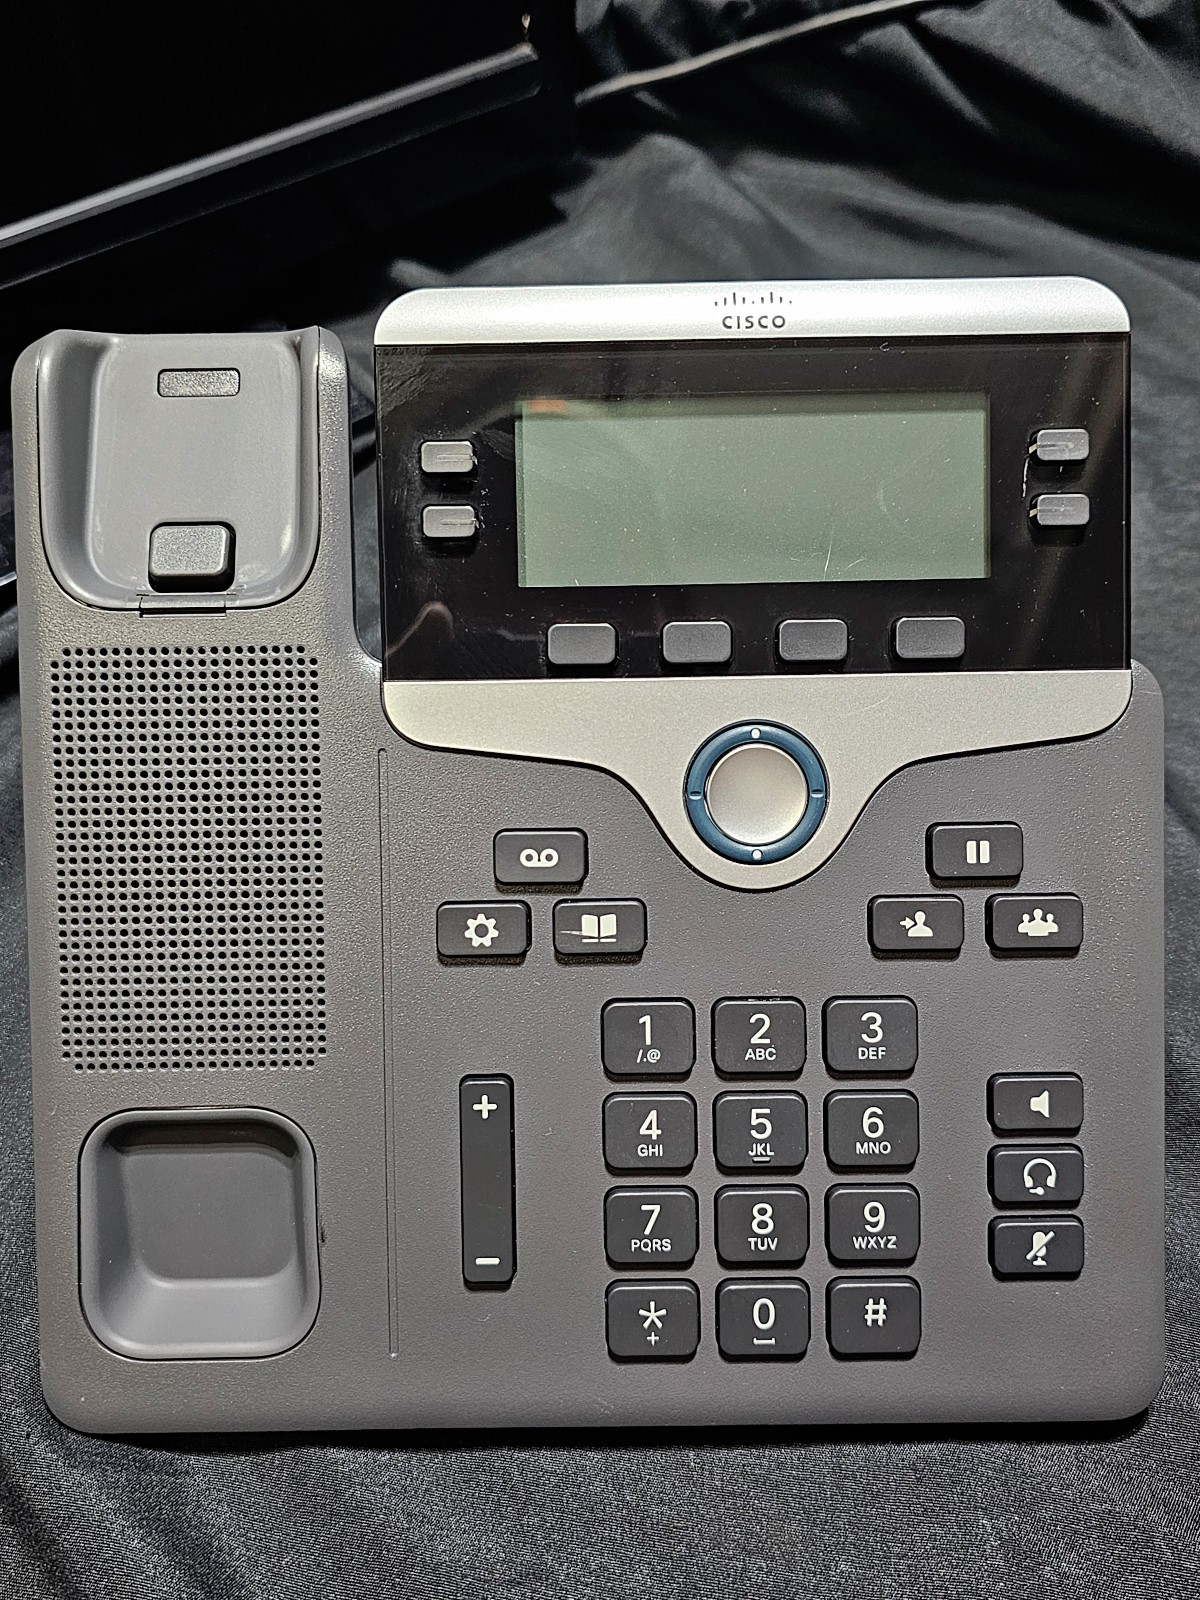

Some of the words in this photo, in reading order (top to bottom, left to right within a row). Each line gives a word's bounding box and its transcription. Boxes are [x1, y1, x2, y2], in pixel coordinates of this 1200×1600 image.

[721, 314, 787, 330] CISCO
[638, 1013, 653, 1046] 1
[749, 1013, 771, 1044] 2
[860, 1011, 884, 1044] 3
[744, 1047, 777, 1062] ABC
[857, 1046, 888, 1061] DEF
[639, 1109, 662, 1141] 4
[750, 1108, 773, 1140] 5
[862, 1106, 885, 1139] 6
[637, 1143, 664, 1158] GHI
[747, 1142, 775, 1157] JKL
[855, 1141, 892, 1155] MNO
[640, 1204, 661, 1236] 7
[751, 1202, 774, 1235] 8
[863, 1201, 886, 1233] 9
[631, 1238, 672, 1254] PQRS
[747, 1237, 778, 1251] TUV
[852, 1235, 897, 1250] WXYZ
[752, 1297, 776, 1330] 0
[864, 1297, 888, 1327] #
